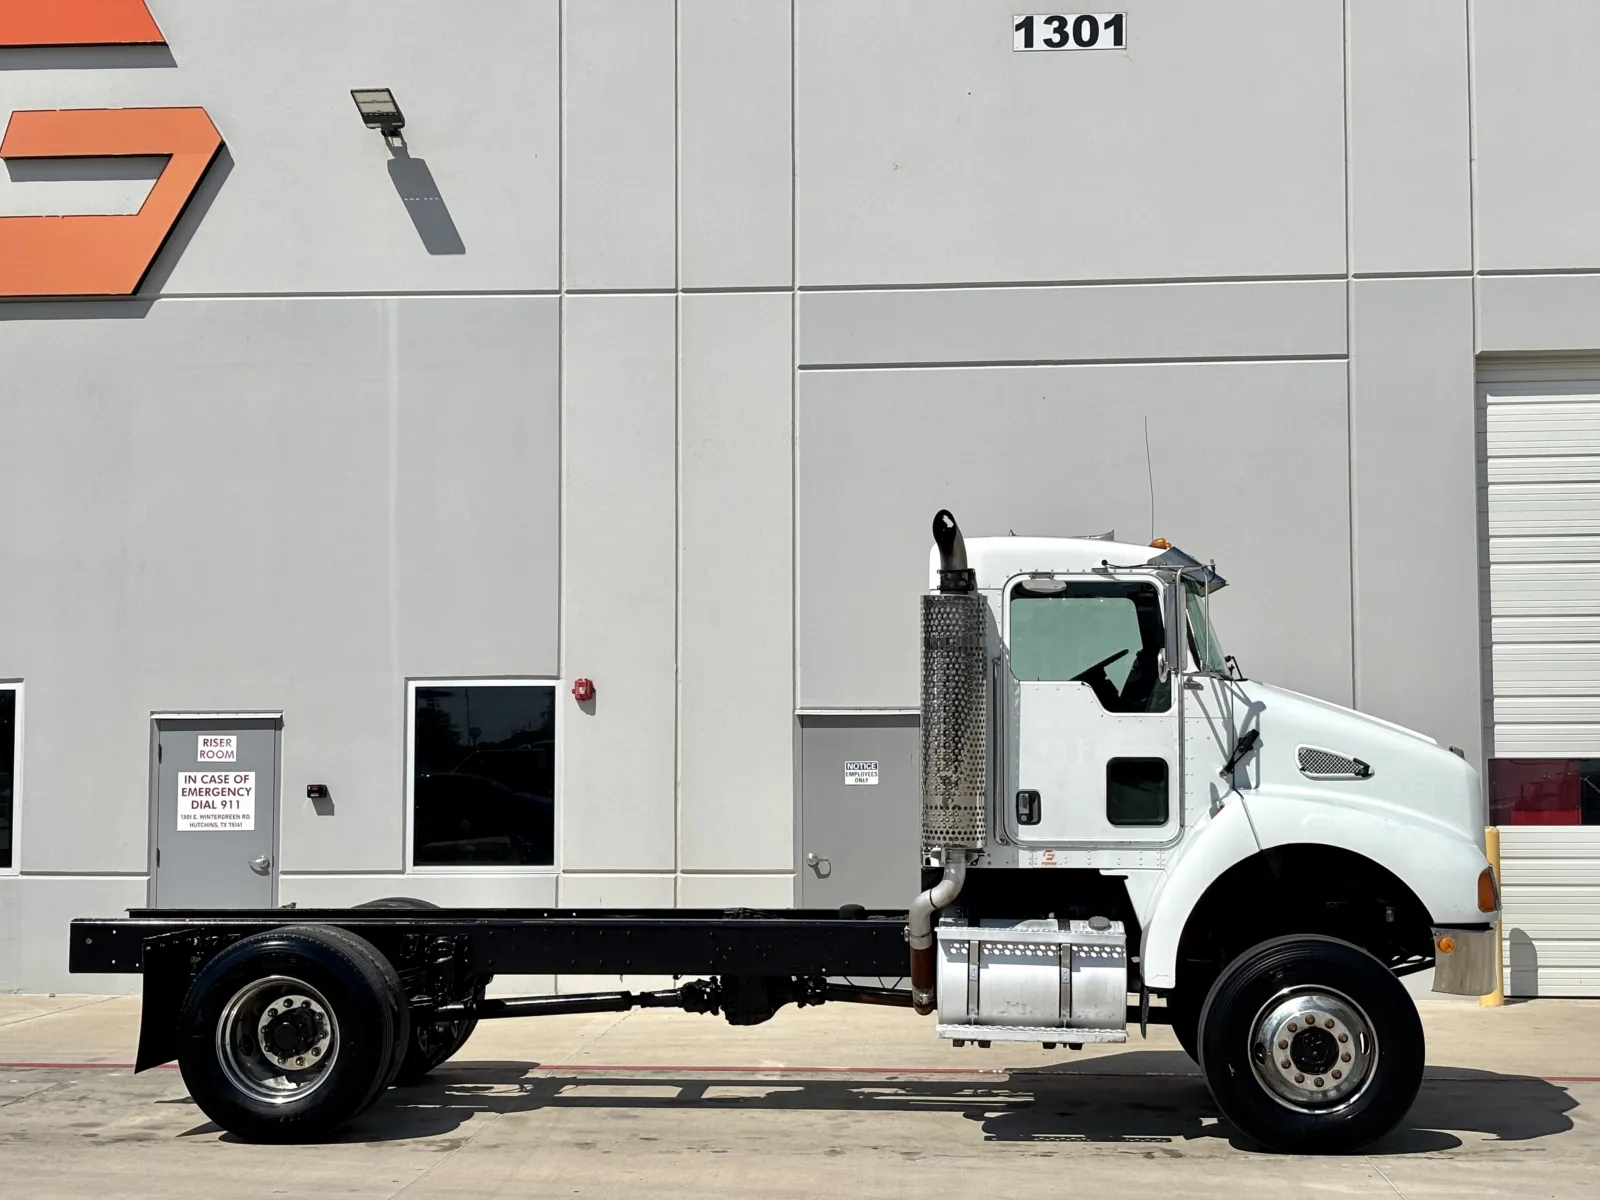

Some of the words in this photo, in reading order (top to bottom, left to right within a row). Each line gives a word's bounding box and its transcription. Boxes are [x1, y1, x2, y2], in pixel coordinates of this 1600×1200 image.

[1015, 14, 1123, 48] 1301
[203, 738, 232, 747] RISER
[200, 750, 235, 759] ROOM
[847, 762, 877, 770] NOTICE
[184, 775, 197, 784] IN
[201, 774, 230, 784] CASE
[233, 774, 250, 784] OF
[181, 787, 252, 797] EMERGENCY
[191, 800, 217, 809] DIAL
[220, 800, 240, 809] 911
